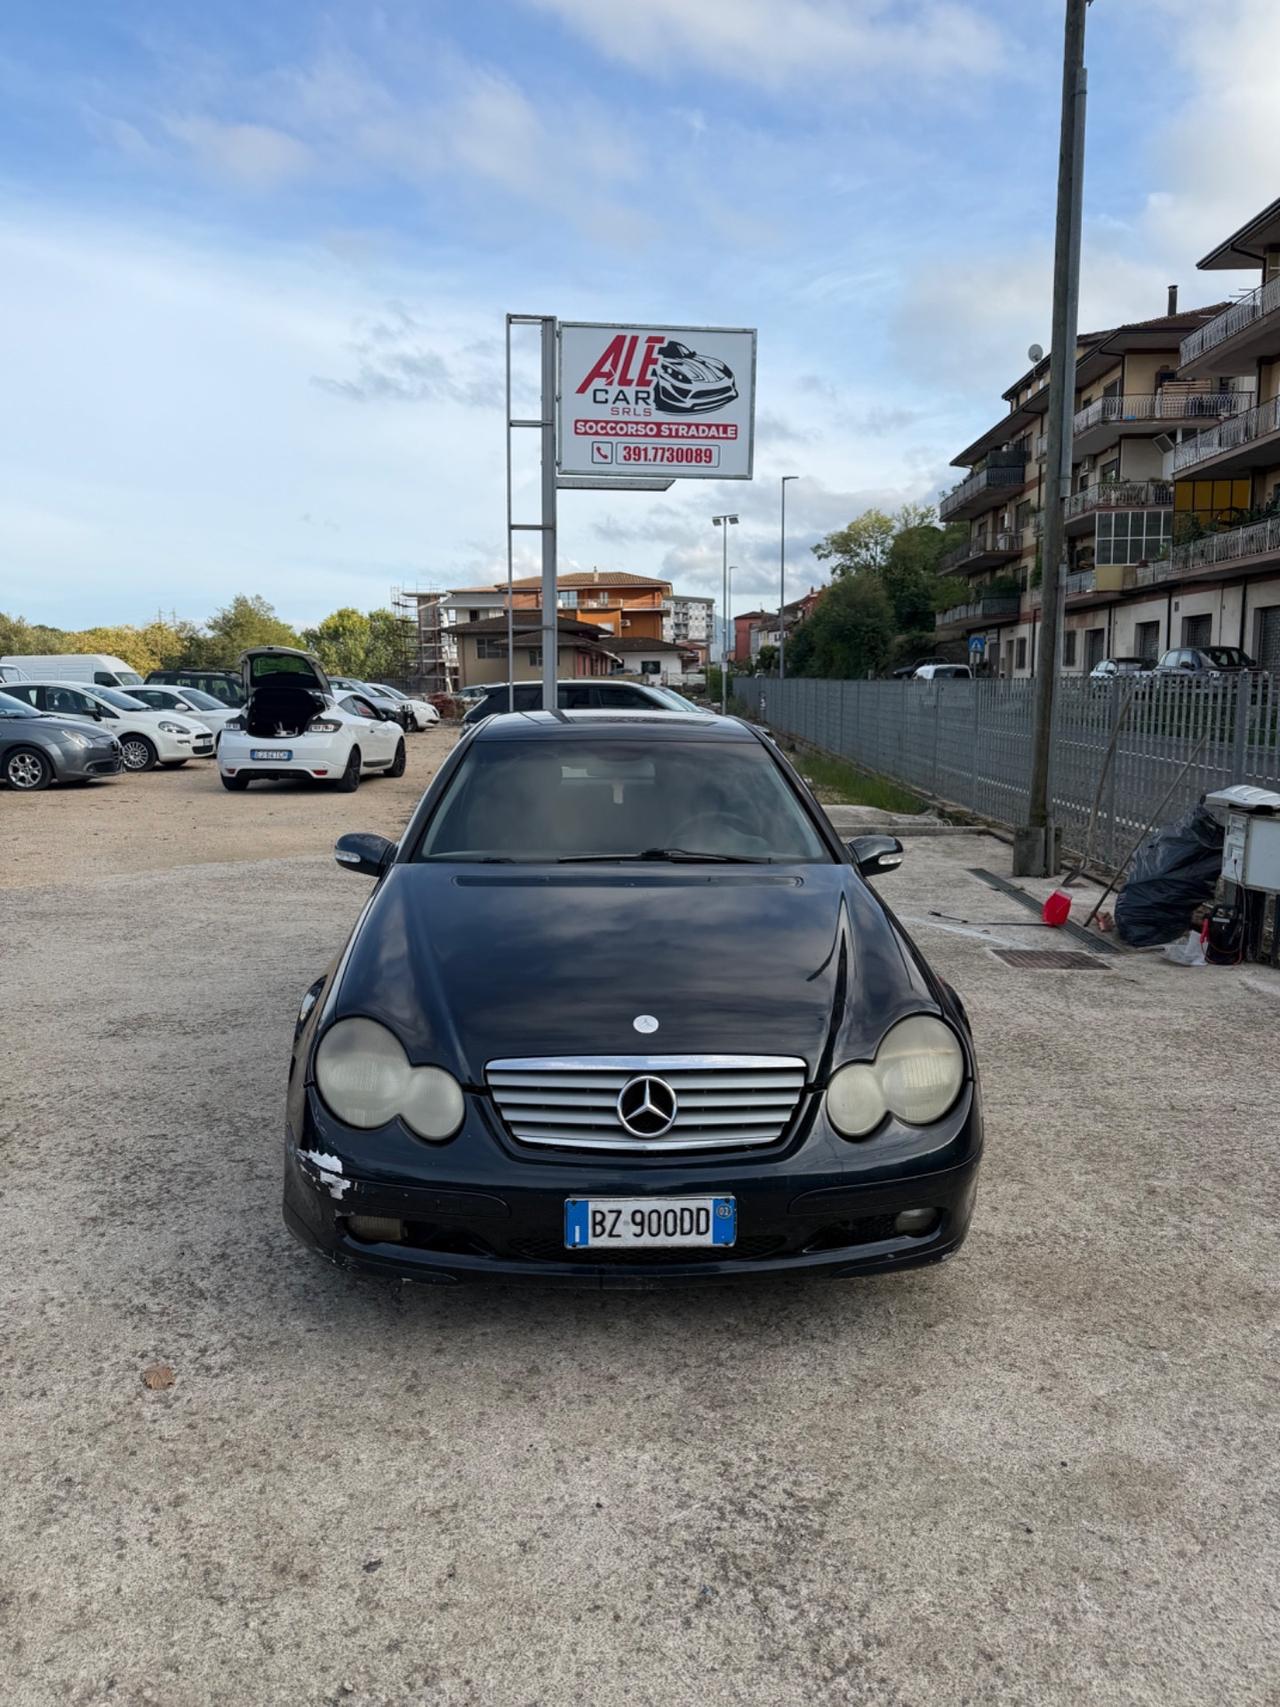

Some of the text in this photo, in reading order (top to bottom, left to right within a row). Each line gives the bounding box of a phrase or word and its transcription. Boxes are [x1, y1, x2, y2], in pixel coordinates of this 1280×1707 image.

[575, 335, 666, 394] ALE
[592, 388, 651, 406] CAR
[610, 407, 652, 417] SRLS
[576, 422, 737, 438] SOCCORSO STRADALE
[623, 446, 713, 464] 391.7730089
